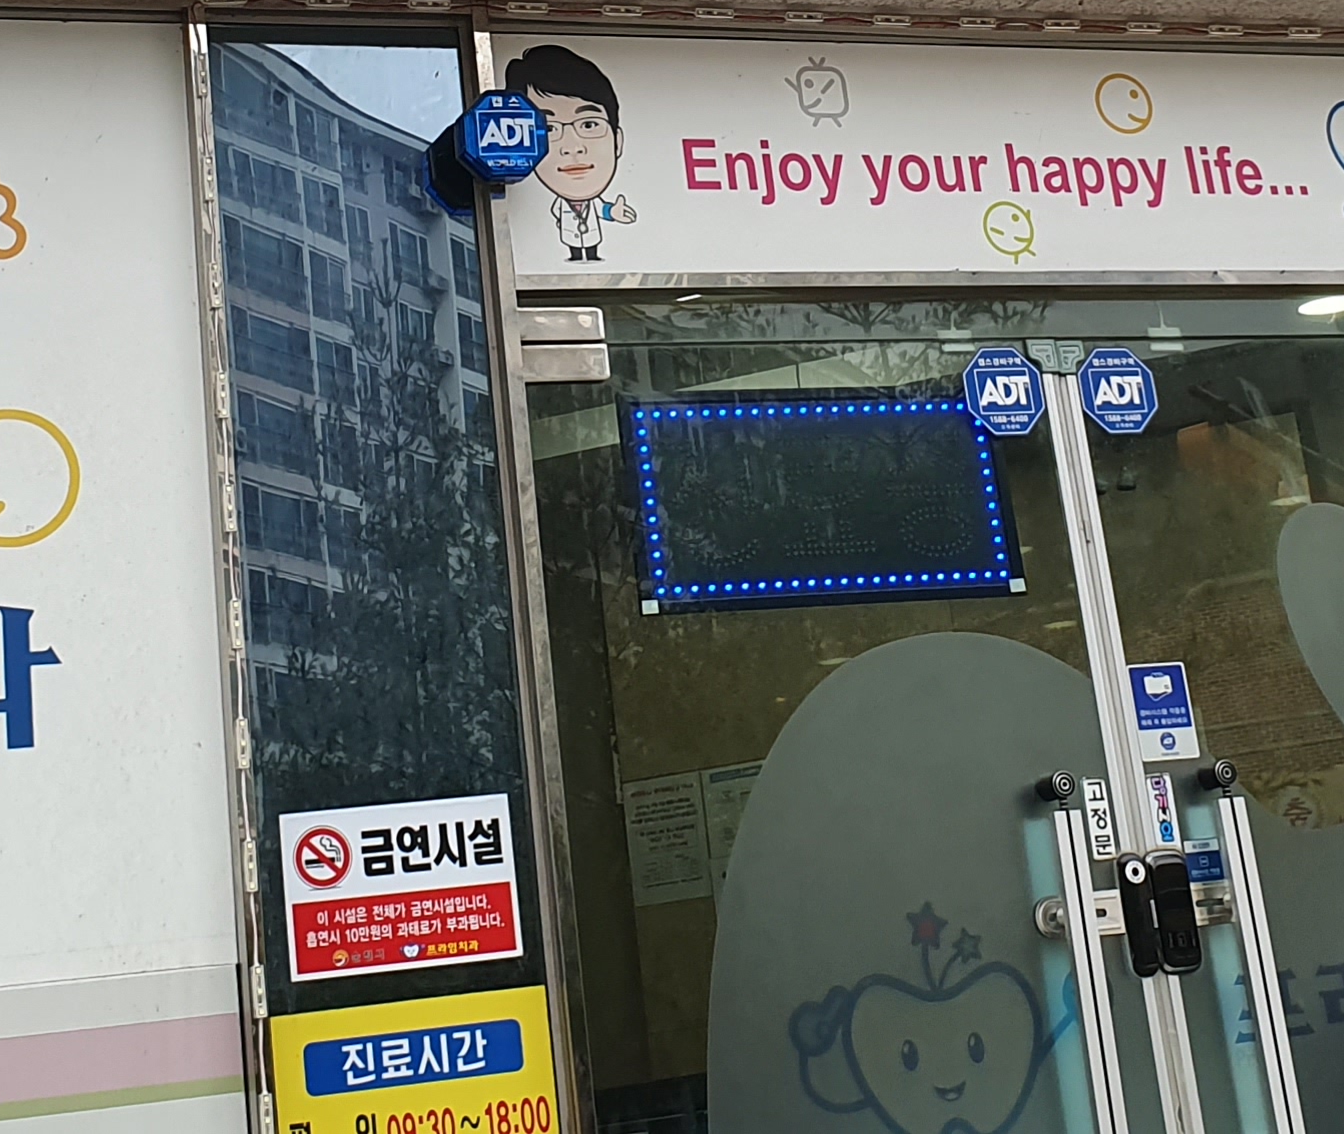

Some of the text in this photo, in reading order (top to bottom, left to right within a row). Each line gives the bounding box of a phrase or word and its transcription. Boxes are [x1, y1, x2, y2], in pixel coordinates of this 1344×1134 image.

[480, 117, 535, 147] ADT
[681, 138, 1309, 208] Enjoy your happy life...
[980, 375, 1029, 406] ADT
[1095, 375, 1142, 406] ADT
[1086, 781, 1113, 856] 고정문
[360, 817, 505, 877] 금연시설
[316, 893, 492, 926] 이 시설은 전체가 금연시설입니다.
[305, 912, 505, 948] 흡연시 10만원의 과태료가 부과됩니다.
[426, 940, 479, 957] 프라임치과
[341, 1028, 488, 1087] 진료시간
